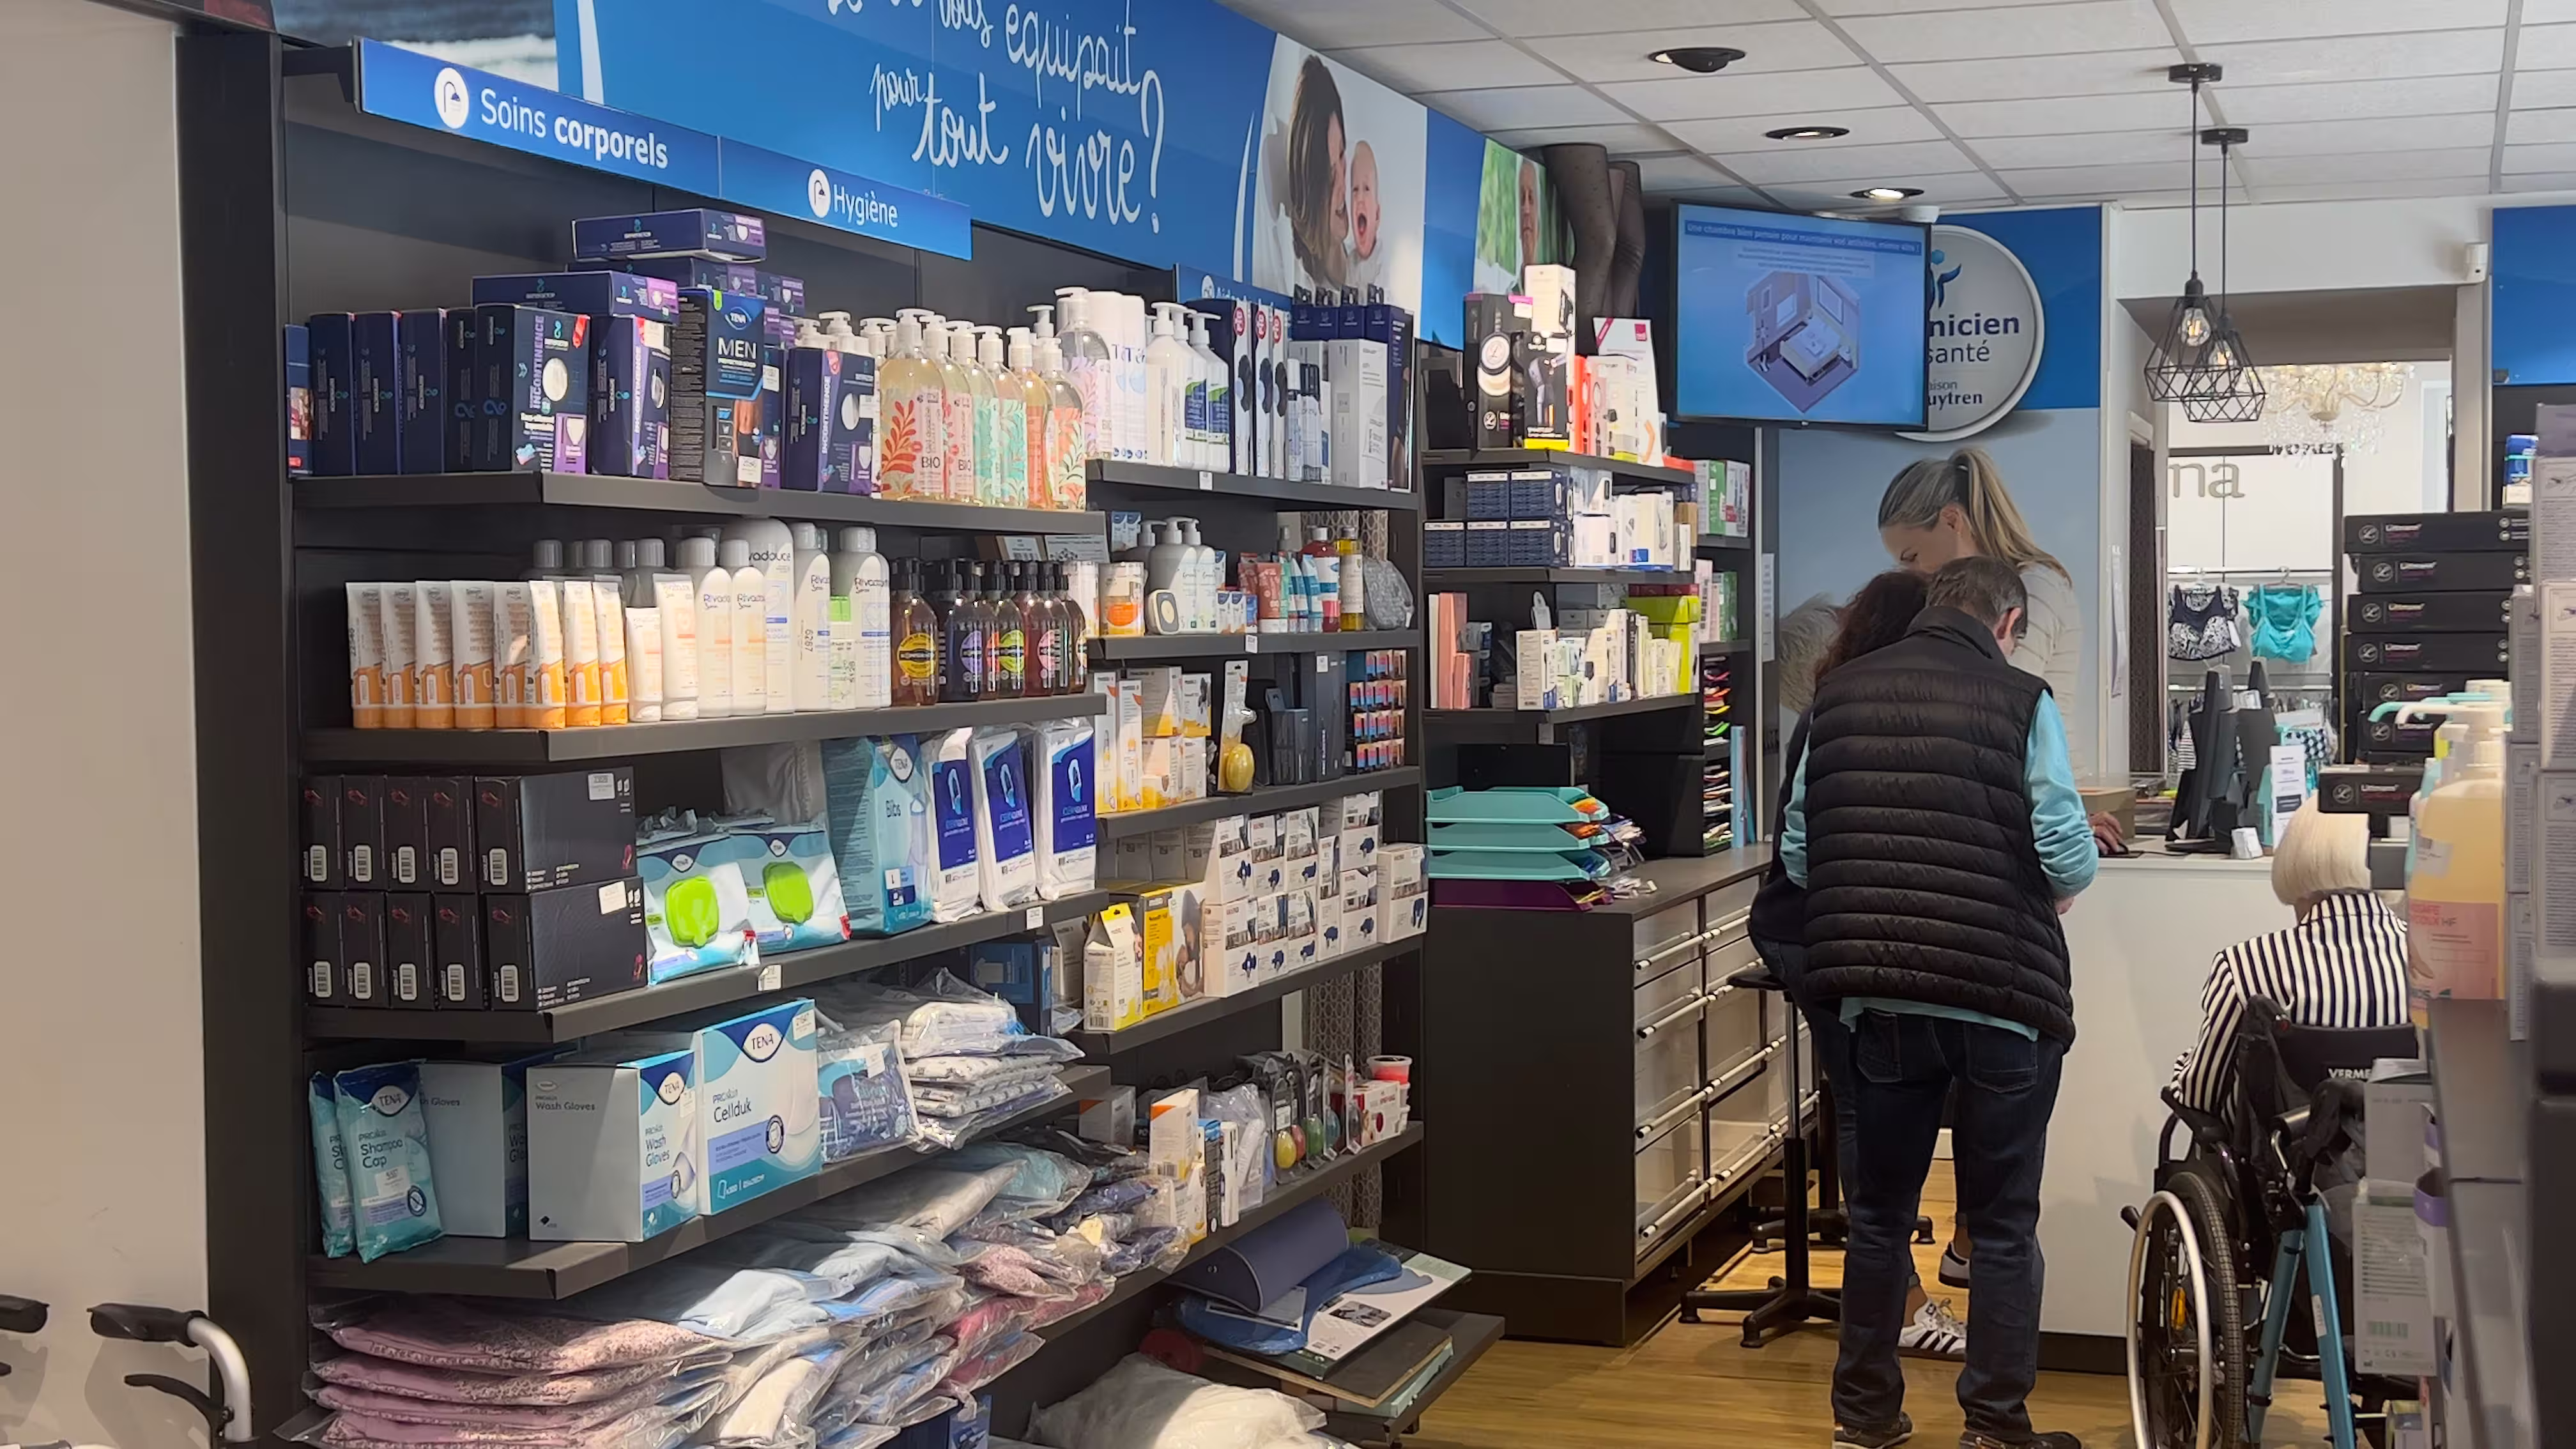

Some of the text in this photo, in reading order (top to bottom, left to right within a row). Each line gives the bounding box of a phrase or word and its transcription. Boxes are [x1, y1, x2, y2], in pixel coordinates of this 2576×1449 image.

[870, 62, 926, 132] pour
[912, 72, 1009, 167] tout
[480, 88, 668, 169] Soins corporels
[833, 188, 898, 229] Hygiène
[717, 337, 757, 360] MEN
[921, 456, 940, 469] BIO
[751, 1033, 774, 1050] TENA
[535, 1101, 596, 1111] Wash Gloves
[714, 1097, 752, 1123] Cellduk
[360, 1138, 404, 1156] Shampoo
[362, 1156, 387, 1169] Cap
